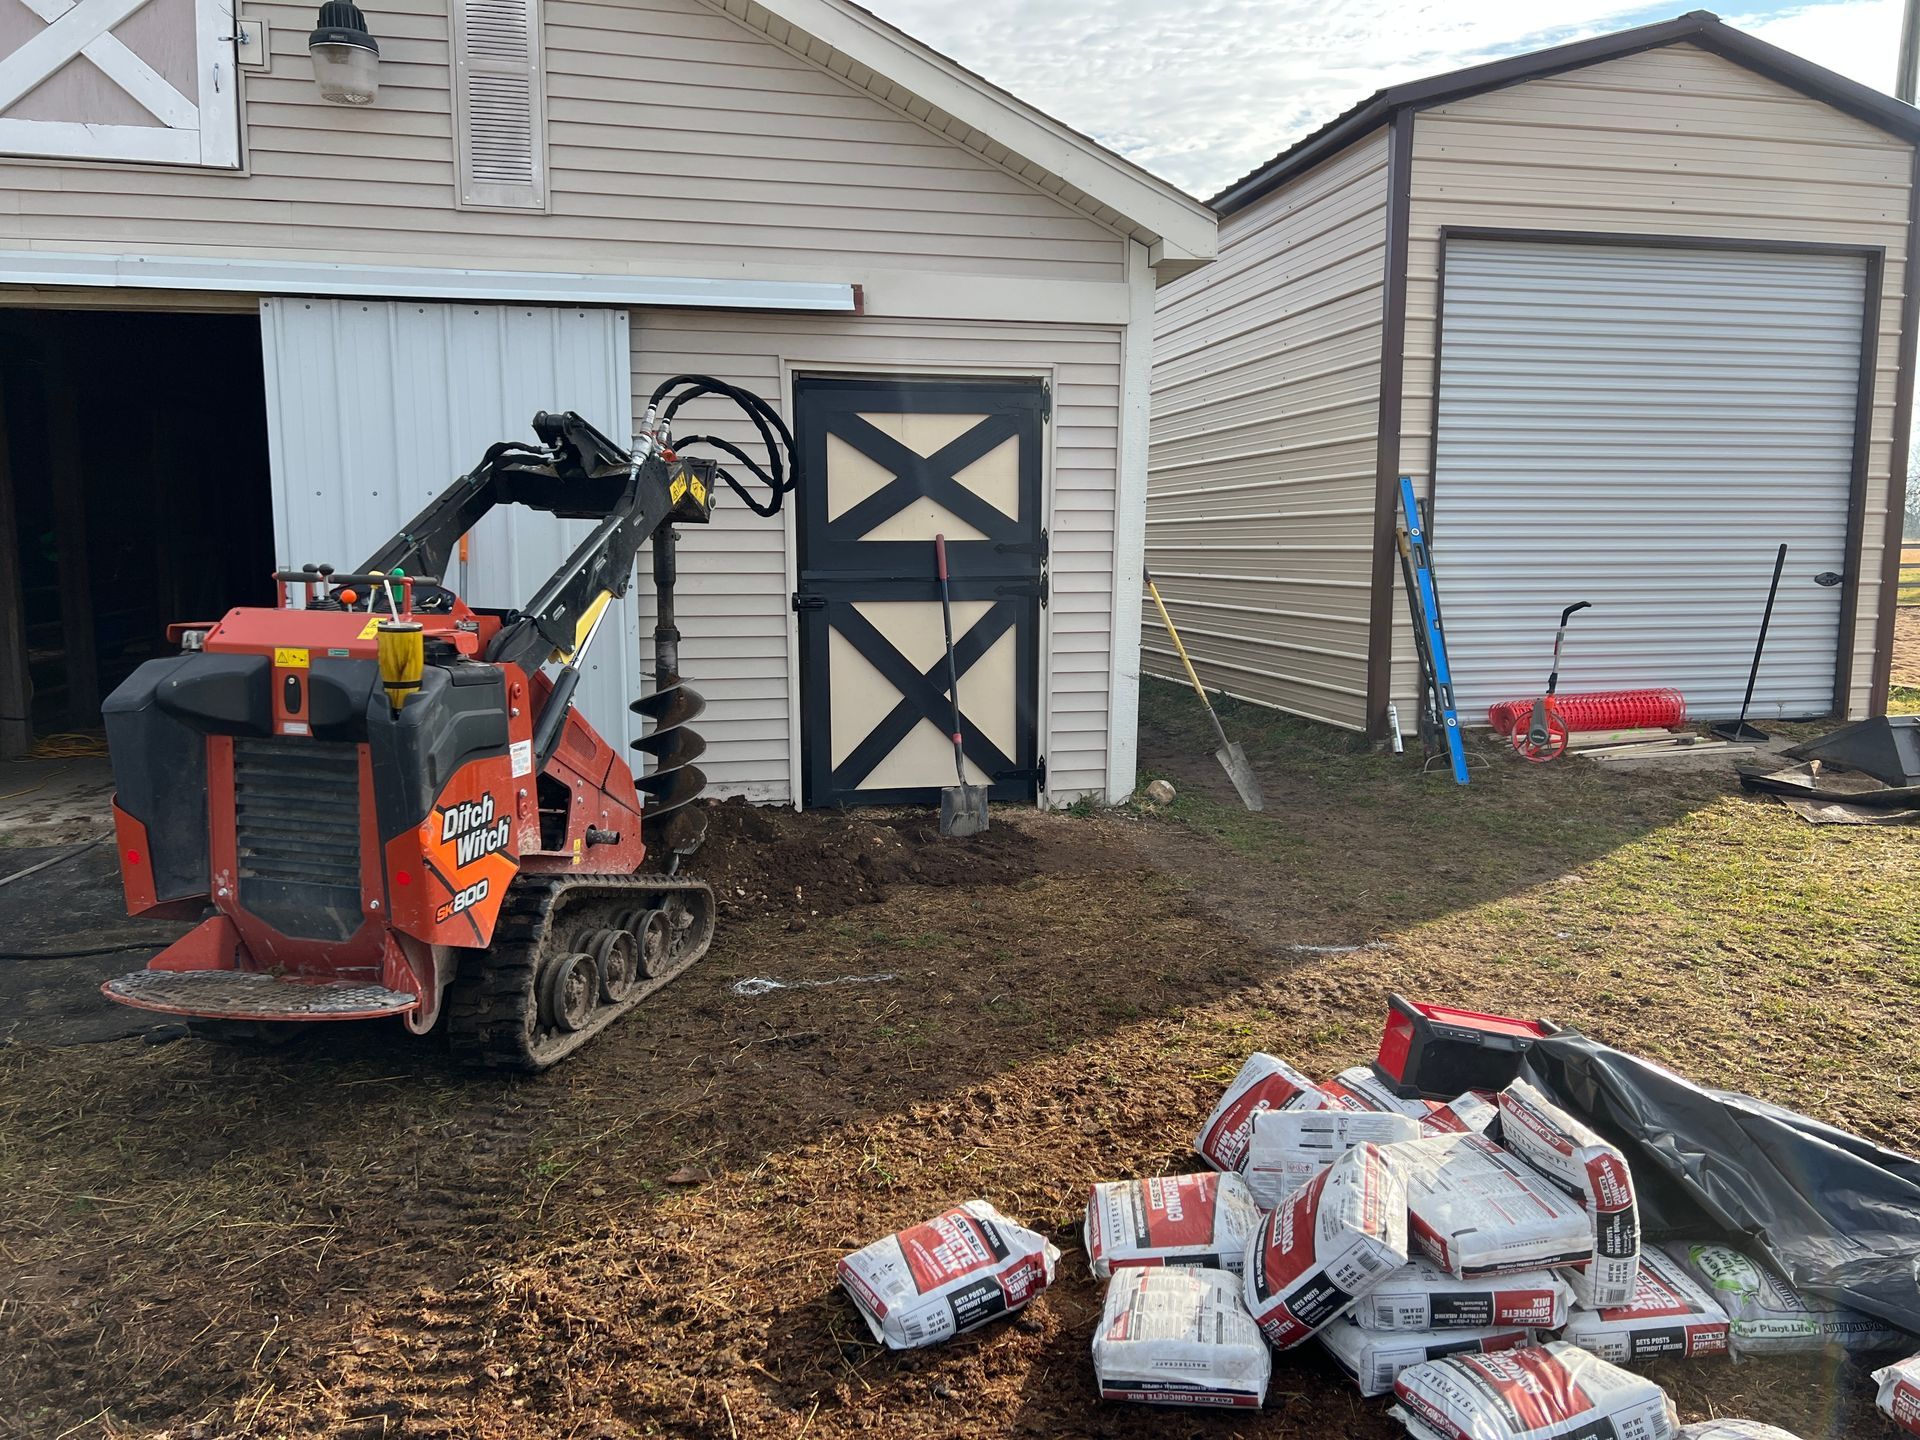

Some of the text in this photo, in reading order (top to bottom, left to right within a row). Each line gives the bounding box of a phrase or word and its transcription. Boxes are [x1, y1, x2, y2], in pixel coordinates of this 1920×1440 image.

[443, 795, 493, 840] Ditch
[457, 819, 508, 866] Witch
[437, 879, 488, 922] SK800
[1342, 1095, 1361, 1111] FAST
[1215, 1130, 1231, 1160] MIX
[1601, 1160, 1622, 1205] CONCRETE
[1150, 1178, 1162, 1208] FAST SE
[1162, 1179, 1184, 1221] CONCRE
[1620, 1184, 1630, 1204] MIX
[982, 1221, 1000, 1248] PURPOSE
[1274, 1223, 1282, 1245] FAST
[968, 1236, 986, 1257] SET
[932, 1243, 962, 1274] MIX
[1702, 1256, 1724, 1278] New
[1712, 1249, 1738, 1276] Plant
[1728, 1252, 1750, 1272] Life
[953, 1287, 987, 1307] SETS POSTS
[956, 1288, 1001, 1314] WITHOUT MIXING
[1011, 1290, 1028, 1301] MIX
[1292, 1288, 1320, 1312] SETS POSTS
[1532, 1297, 1551, 1307] MIX
[1654, 1287, 1673, 1305] SET
[1298, 1297, 1318, 1317] WITHOUT
[1502, 1306, 1550, 1318] CONCRETE
[936, 1318, 946, 1326] LBS
[1760, 1325, 1790, 1337] Plant
[1791, 1324, 1812, 1334] Life
[1636, 1336, 1670, 1346] SETS POSTS
[1636, 1345, 1662, 1353] WITHOUT
[1480, 1359, 1507, 1379] FAST
[1147, 1393, 1192, 1401] CONCRETE
[1901, 1391, 1920, 1406] FAST
[1895, 1406, 1912, 1425] MIX
[1896, 1398, 1920, 1419] CONC
[1622, 1421, 1633, 1430] NET
[1633, 1426, 1645, 1436] LBS
